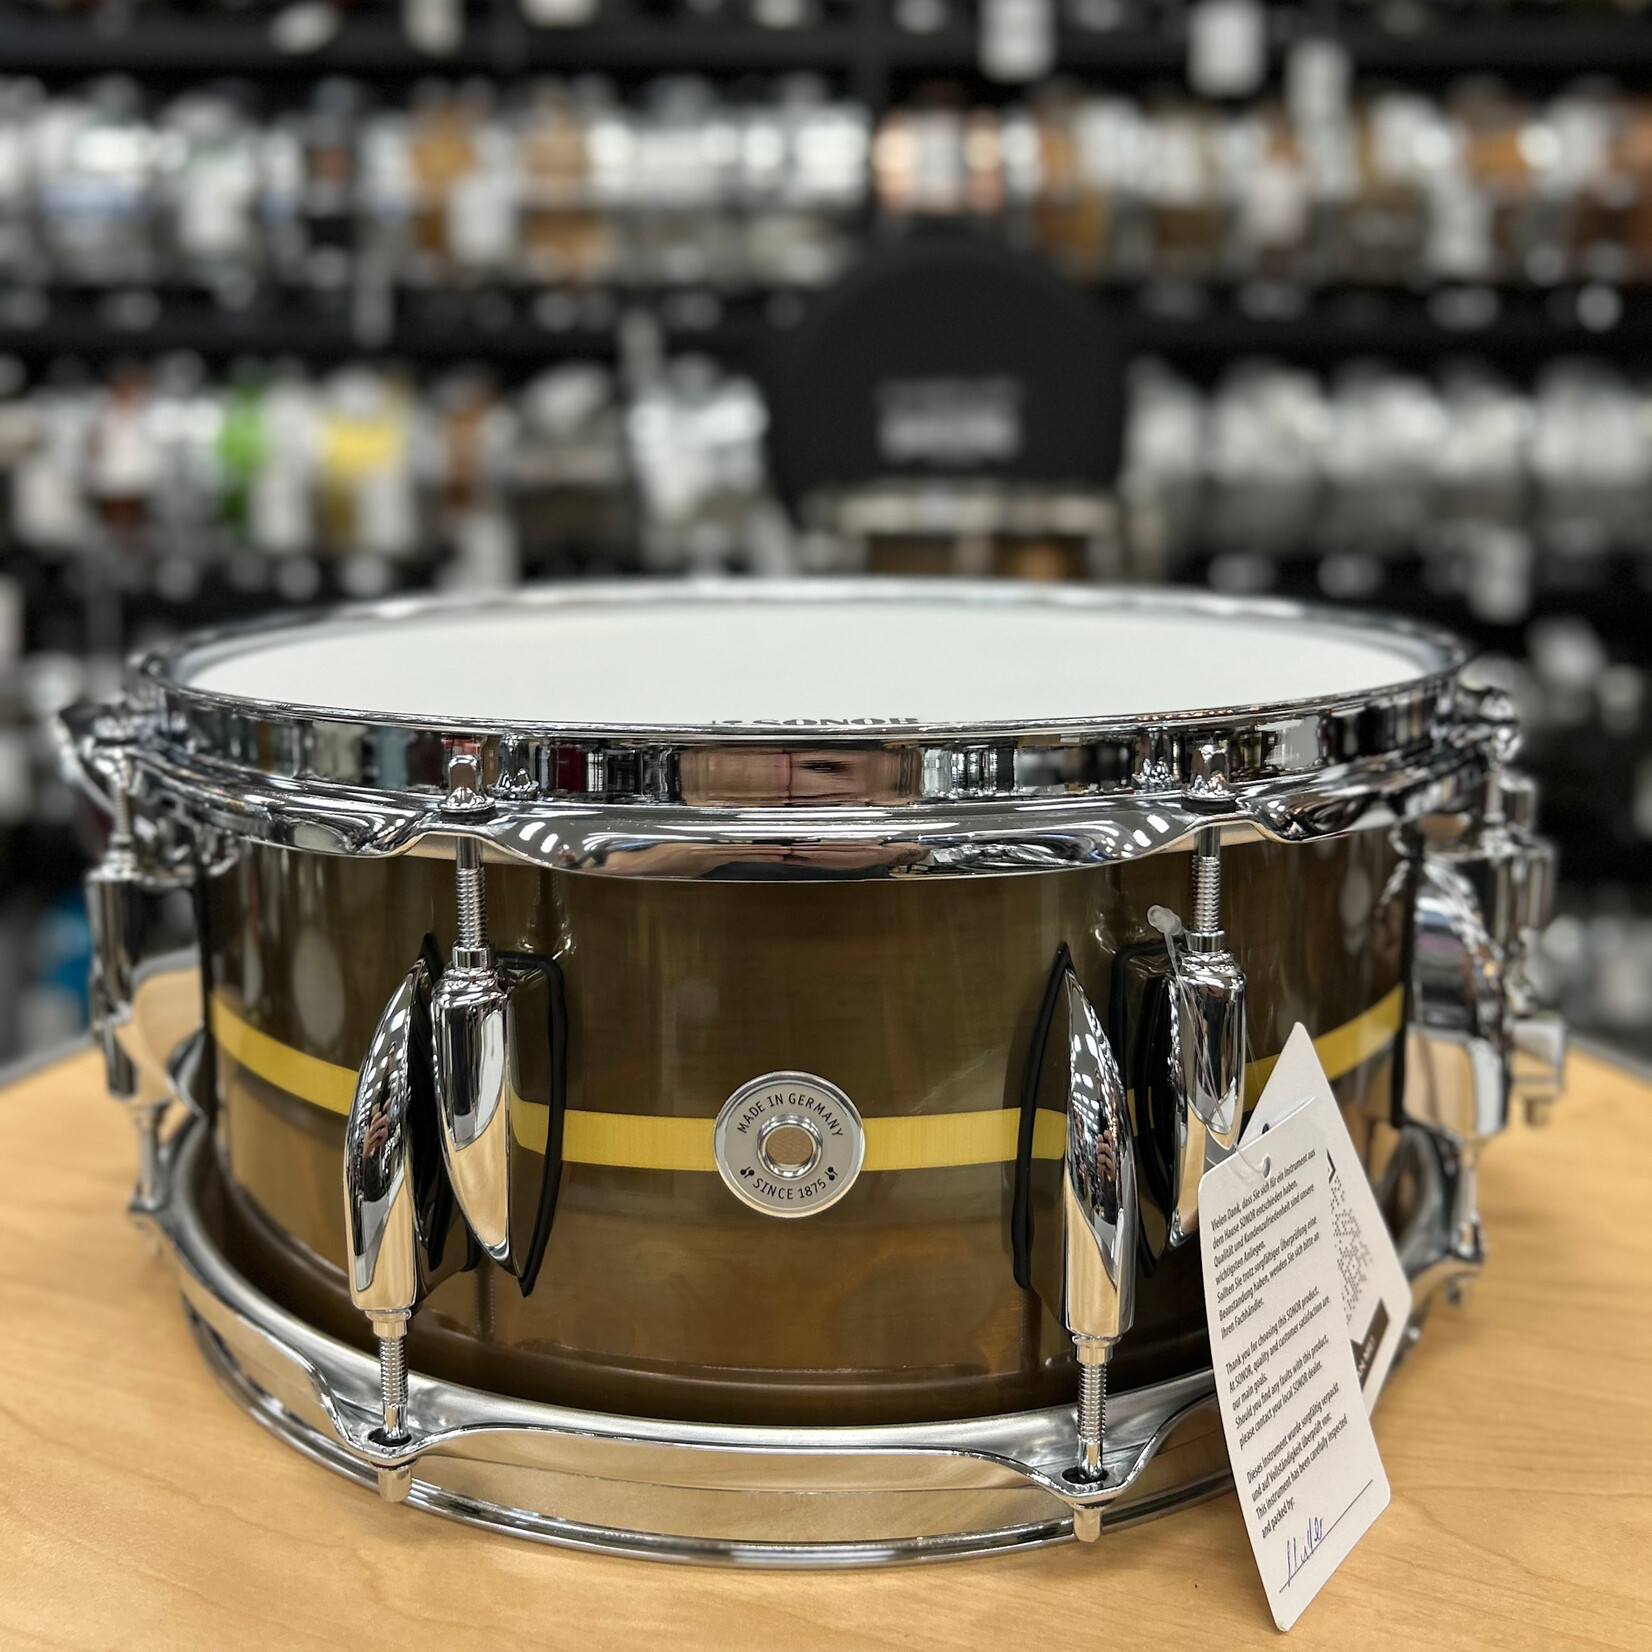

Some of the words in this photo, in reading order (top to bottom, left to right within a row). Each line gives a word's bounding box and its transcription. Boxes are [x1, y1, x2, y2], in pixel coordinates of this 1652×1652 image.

[737, 1100, 766, 1134] MADE
[766, 1093, 784, 1107] IN
[788, 1093, 844, 1137] GERMANY
[753, 1179, 793, 1200] SINCE
[798, 1179, 827, 1199] 1875
[1211, 1214, 1227, 1232] Vielen
[1228, 1203, 1242, 1220] Dank,
[1242, 1195, 1253, 1210] dass
[1261, 1180, 1270, 1196] sich
[1284, 1154, 1308, 1178] Instrument
[1308, 1149, 1316, 1160] aus
[1213, 1235, 1224, 1250] dem
[1224, 1224, 1240, 1241] Hause
[1240, 1209, 1256, 1230] SONOR
[1256, 1191, 1283, 1217] entschieden
[1283, 1180, 1298, 1196] haben.
[1214, 1245, 1234, 1268] Qualität
[1234, 1236, 1244, 1252] und
[1244, 1202, 1290, 1244] Kundenzufriedenheit
[1291, 1192, 1300, 1208] sind
[1300, 1184, 1314, 1201] unsere
[1216, 1257, 1244, 1285] wichtigsten
[1244, 1241, 1266, 1264] Anliegen.
[1217, 1284, 1235, 1304] Sollten
[1243, 1267, 1255, 1283] trotz
[1255, 1246, 1280, 1273] sorgfältiger
[1280, 1225, 1308, 1252] Überprüfung
[1308, 1216, 1317, 1230] eine
[1220, 1288, 1254, 1321] Beanstandung
[1253, 1275, 1270, 1293] haben,
[1269, 1259, 1288, 1279] wenden
[1287, 1252, 1295, 1265] Sie
[1295, 1244, 1304, 1258] sich
[1303, 1237, 1314, 1251] bitte
[1314, 1232, 1320, 1242] an
[1221, 1322, 1235, 1340] Ihren
[1235, 1298, 1264, 1328] Fachhändler.
[1226, 1354, 1242, 1375] Thank
[1241, 1348, 1251, 1365] you
[1250, 1341, 1258, 1354] for
[1258, 1323, 1278, 1347] choosing
[1278, 1314, 1288, 1329] this
[1286, 1300, 1302, 1321] SONOR
[1302, 1286, 1319, 1310] product.
[1230, 1381, 1236, 1394] At
[1235, 1364, 1254, 1388] SONOR,
[1254, 1351, 1270, 1373] quality
[1270, 1339, 1279, 1356] and
[1279, 1324, 1299, 1348] customer
[1299, 1302, 1322, 1330] satisfaction
[1233, 1397, 1241, 1411] our
[1241, 1386, 1254, 1403] main
[1254, 1373, 1268, 1394] goals.
[1236, 1405, 1253, 1430] Should
[1252, 1399, 1262, 1416] you
[1261, 1387, 1272, 1404] find
[1272, 1381, 1280, 1395] any
[1280, 1368, 1293, 1387] faults
[1292, 1357, 1304, 1374] with
[1303, 1350, 1312, 1365] this
[1311, 1334, 1329, 1359] product,
[1240, 1427, 1255, 1450] please
[1255, 1408, 1273, 1432] contact
[1272, 1399, 1282, 1419] your
[1282, 1386, 1294, 1405] local
[1293, 1372, 1308, 1394] SONOR
[1308, 1361, 1323, 1380] dealer.
[1247, 1463, 1263, 1484] Dieses
[1262, 1436, 1288, 1468] Instrument
[1288, 1422, 1302, 1442] wurde
[1301, 1402, 1322, 1428] sorgfältig
[1322, 1382, 1339, 1406] verpackt
[1252, 1483, 1262, 1502] und
[1262, 1473, 1270, 1492] auf
[1269, 1442, 1303, 1482] Vollständigkeit
[1302, 1420, 1323, 1448] überprüft
[1322, 1412, 1332, 1427] von:
[1256, 1500, 1267, 1520] This
[1266, 1472, 1292, 1510] instrument
[1290, 1463, 1300, 1484] has
[1298, 1456, 1311, 1474] been
[1310, 1436, 1328, 1461] carefully
[1327, 1414, 1348, 1442] inspected
[1262, 1520, 1272, 1539] and
[1271, 1500, 1288, 1531] packed
[1286, 1497, 1295, 1511] by:
